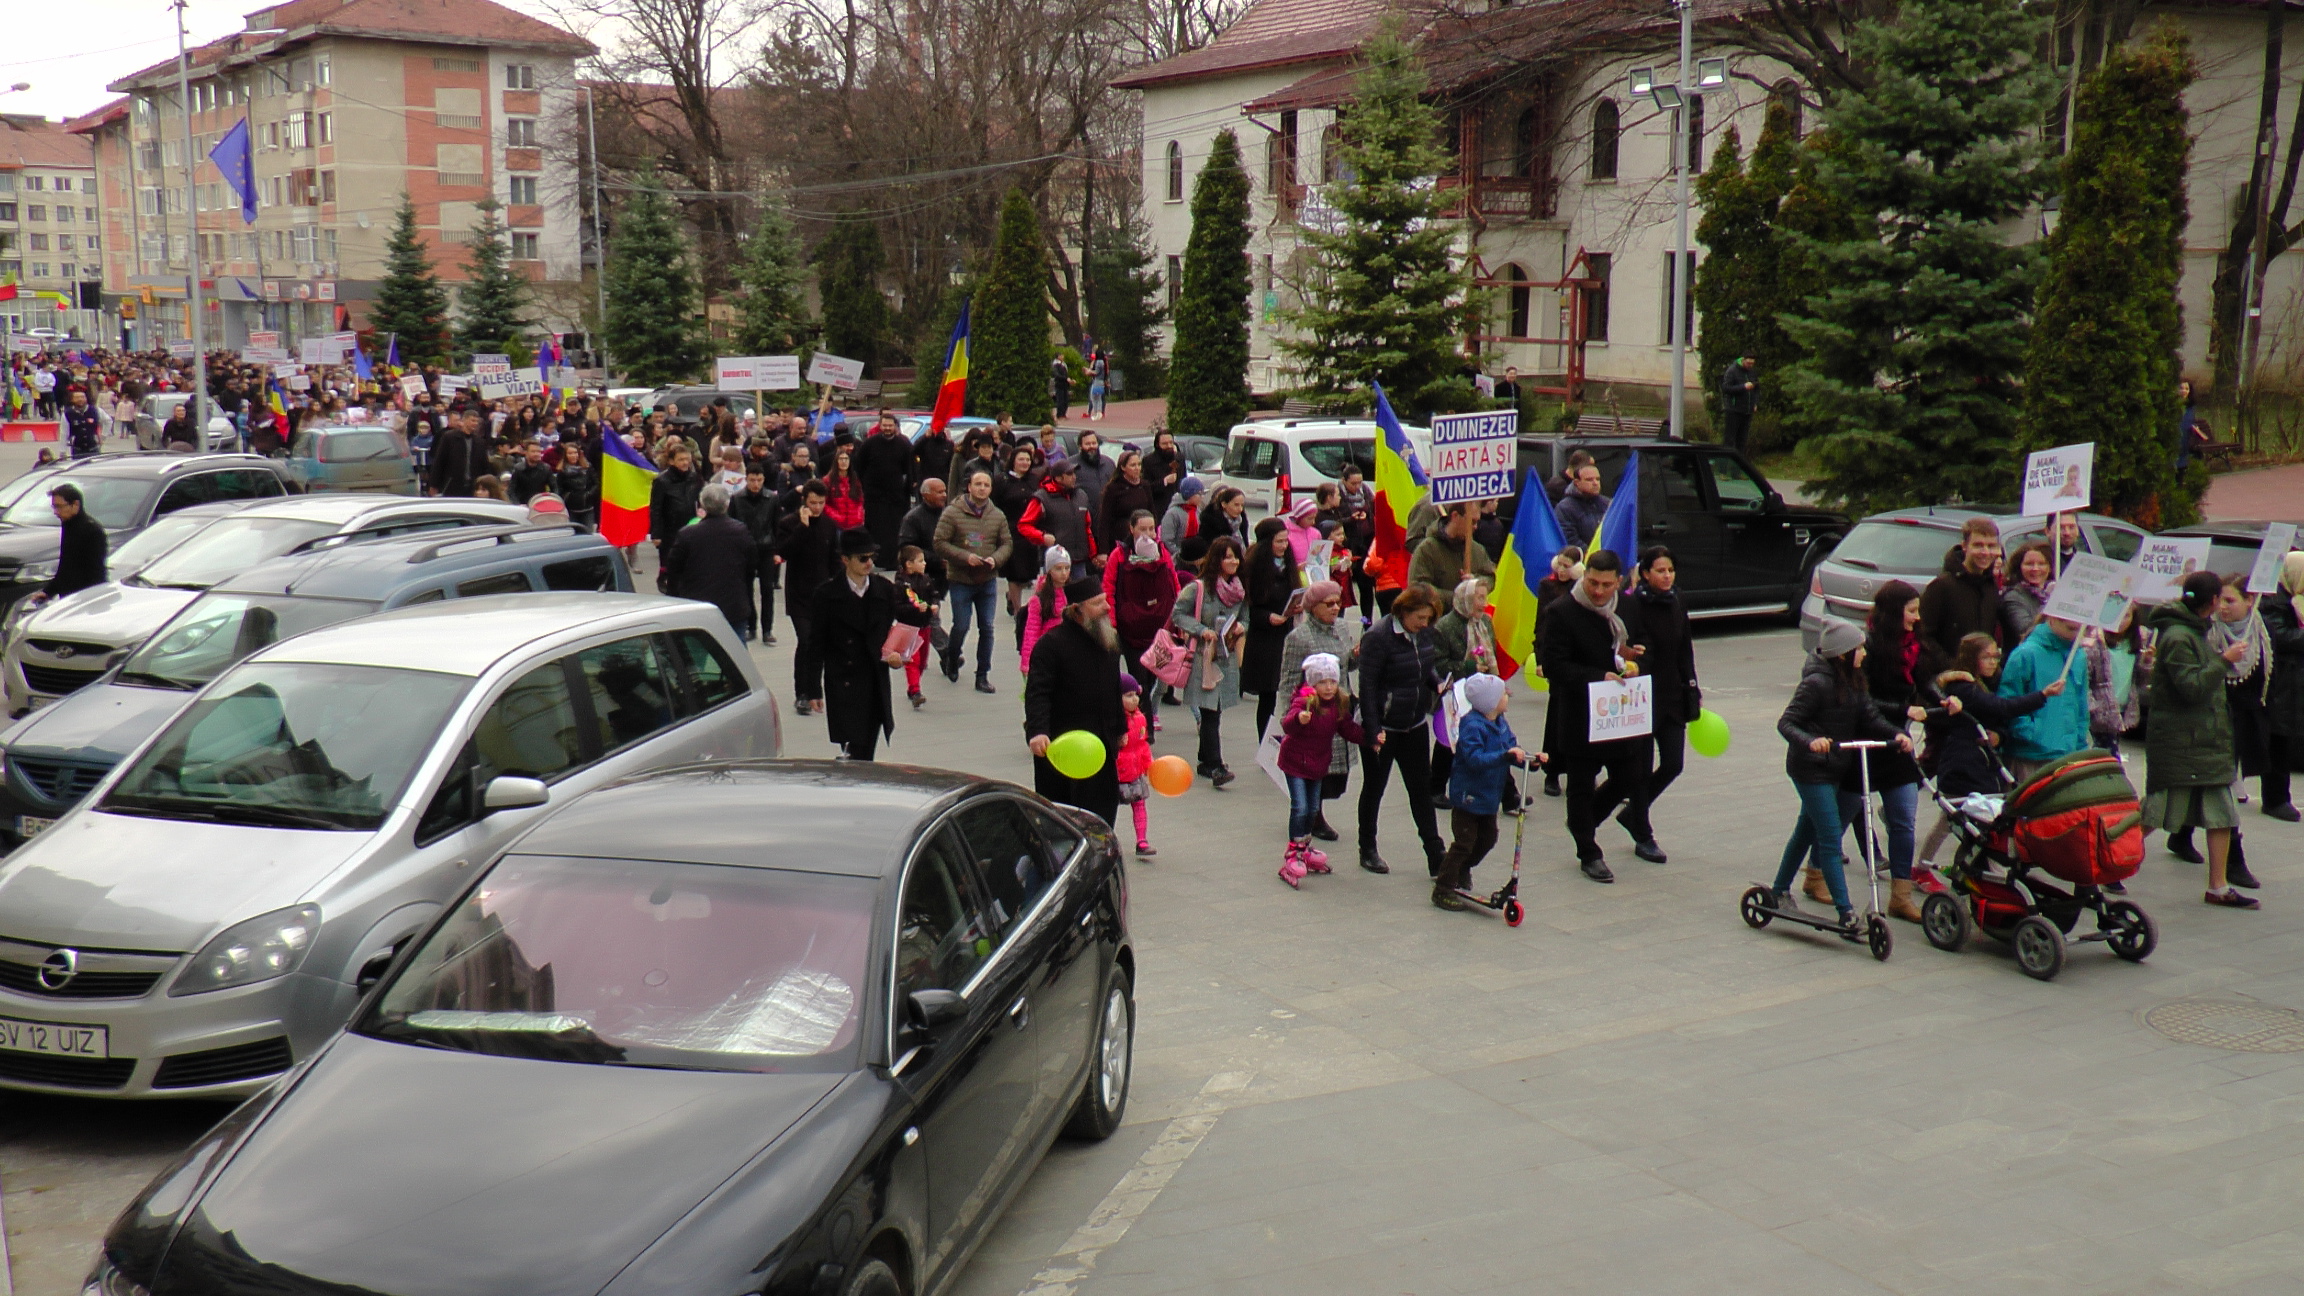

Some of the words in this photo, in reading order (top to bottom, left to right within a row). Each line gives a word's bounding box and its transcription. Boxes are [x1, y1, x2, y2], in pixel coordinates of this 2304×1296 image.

[482, 371, 520, 386] ALEGE
[1435, 415, 1517, 442] DUMNEZEU
[1439, 441, 1491, 472] IARTĂ
[2029, 469, 2039, 480] DE
[2041, 467, 2051, 477] CE
[2053, 464, 2065, 475] NU
[1437, 470, 1511, 500] VINDECĂ
[2143, 553, 2154, 563] DE
[2156, 555, 2168, 564] CE
[2170, 555, 2184, 564] NU
[1596, 716, 1620, 731] SUNT
[1621, 713, 1646, 728] IUBIRE
[28, 1026, 48, 1050] 12
[57, 1029, 95, 1053] UIZ
